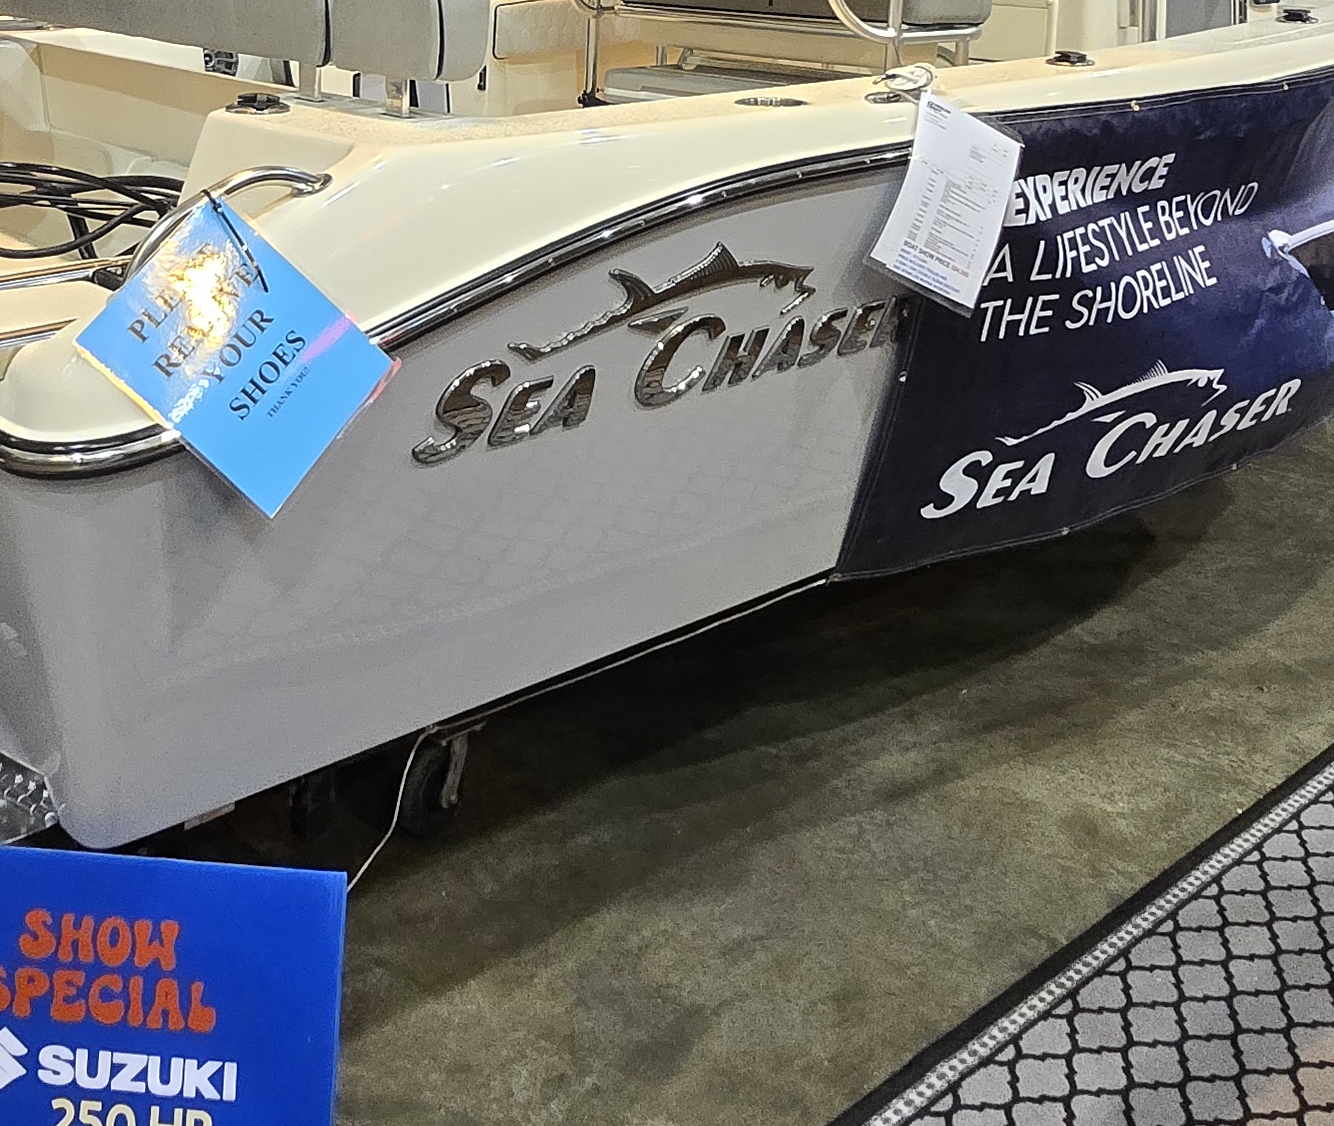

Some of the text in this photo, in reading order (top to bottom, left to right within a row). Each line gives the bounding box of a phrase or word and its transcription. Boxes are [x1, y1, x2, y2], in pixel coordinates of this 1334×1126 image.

[1003, 152, 1176, 227] EXPERIENCE
[981, 243, 1014, 286] A
[1029, 204, 1161, 281] LIFESTYLE
[1156, 181, 1259, 241] BEYOND
[979, 245, 1218, 342] THE SHORELINE
[203, 308, 275, 385] YOUR
[228, 329, 307, 421] SHOES
[267, 385, 293, 418] THANK
[411, 359, 597, 466] SEA
[920, 378, 1302, 519] SEA CHASER
[19, 907, 180, 972] SHOW
[37, 1044, 238, 1102] SUZUKI
[51, 1097, 137, 1126] 250
